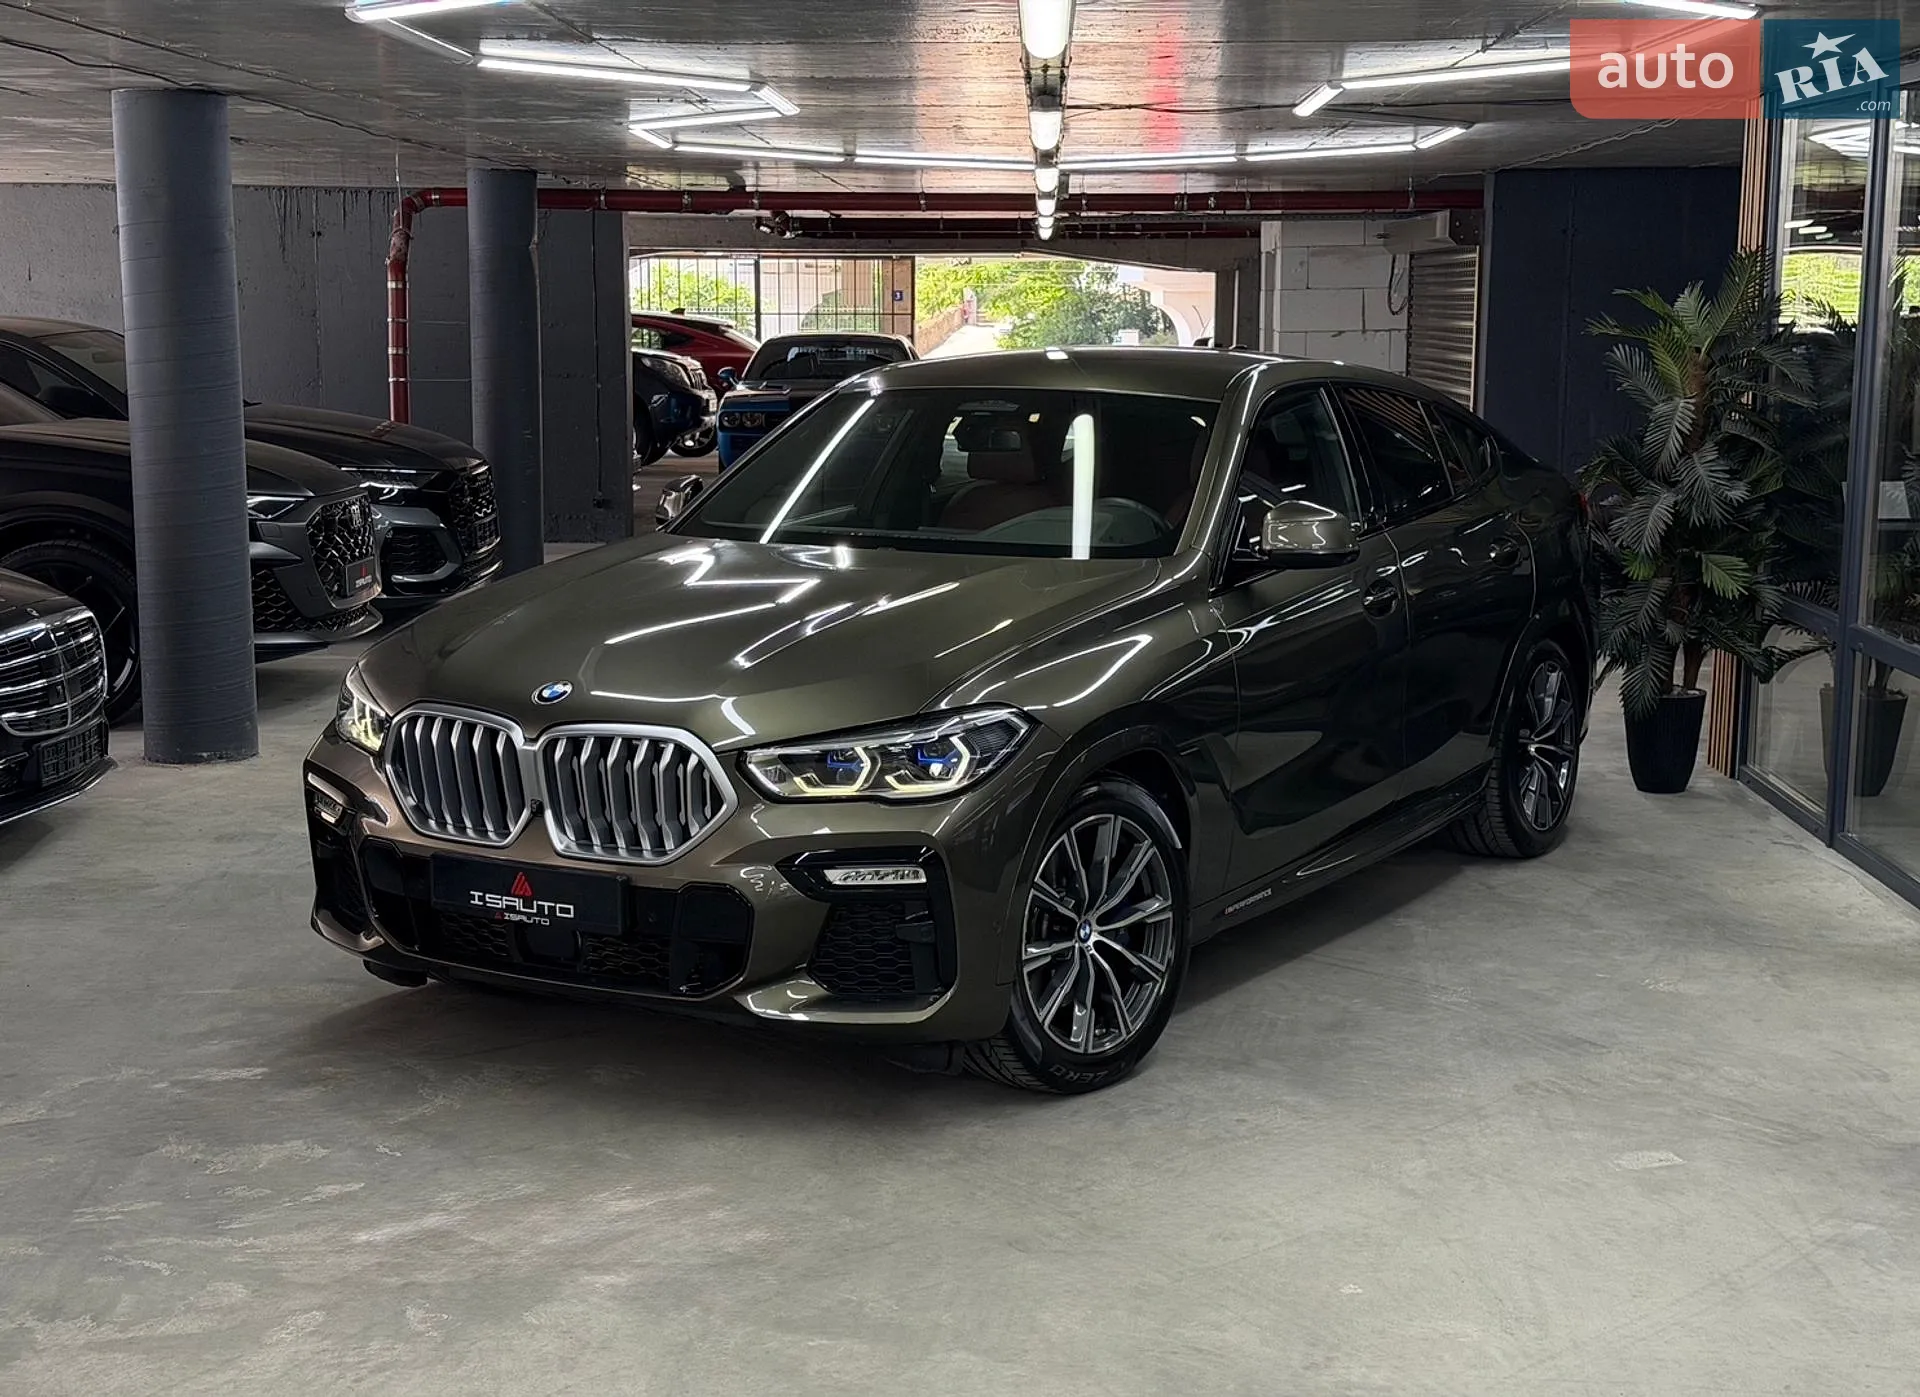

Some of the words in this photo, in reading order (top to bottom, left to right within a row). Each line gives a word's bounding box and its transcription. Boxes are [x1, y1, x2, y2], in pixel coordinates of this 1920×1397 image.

[469, 890, 575, 919] ISAUTO
[503, 912, 550, 926] ISAUTO
[1048, 1063, 1109, 1084] ZERO
